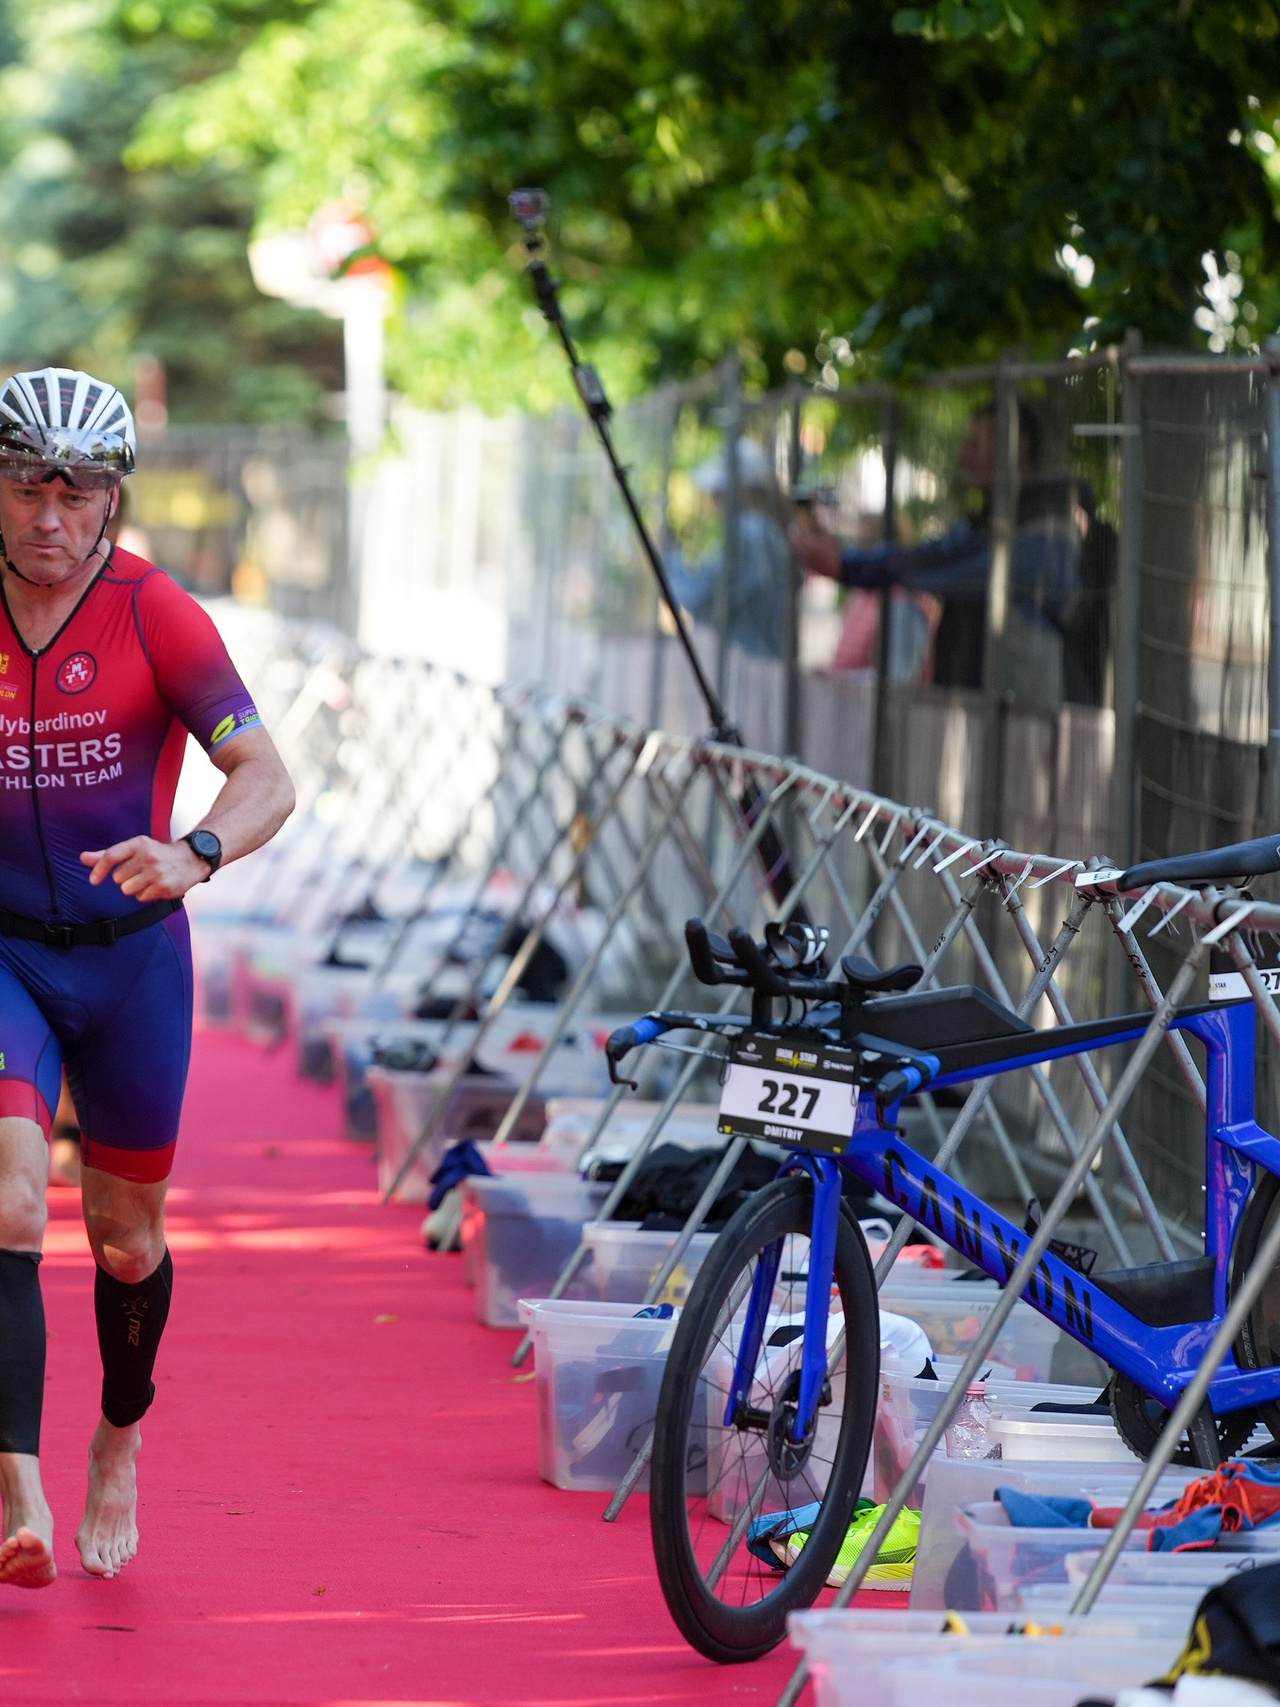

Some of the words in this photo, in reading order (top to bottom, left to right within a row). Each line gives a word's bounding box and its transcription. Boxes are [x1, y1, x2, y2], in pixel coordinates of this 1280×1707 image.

[71, 761, 123, 787] TEAM
[799, 1051, 818, 1065] STAR
[758, 1079, 821, 1120] 227
[763, 1124, 804, 1142] DMITRIY
[883, 1147, 1094, 1343] CANYON
[1240, 1315, 1257, 1370] PIREL
